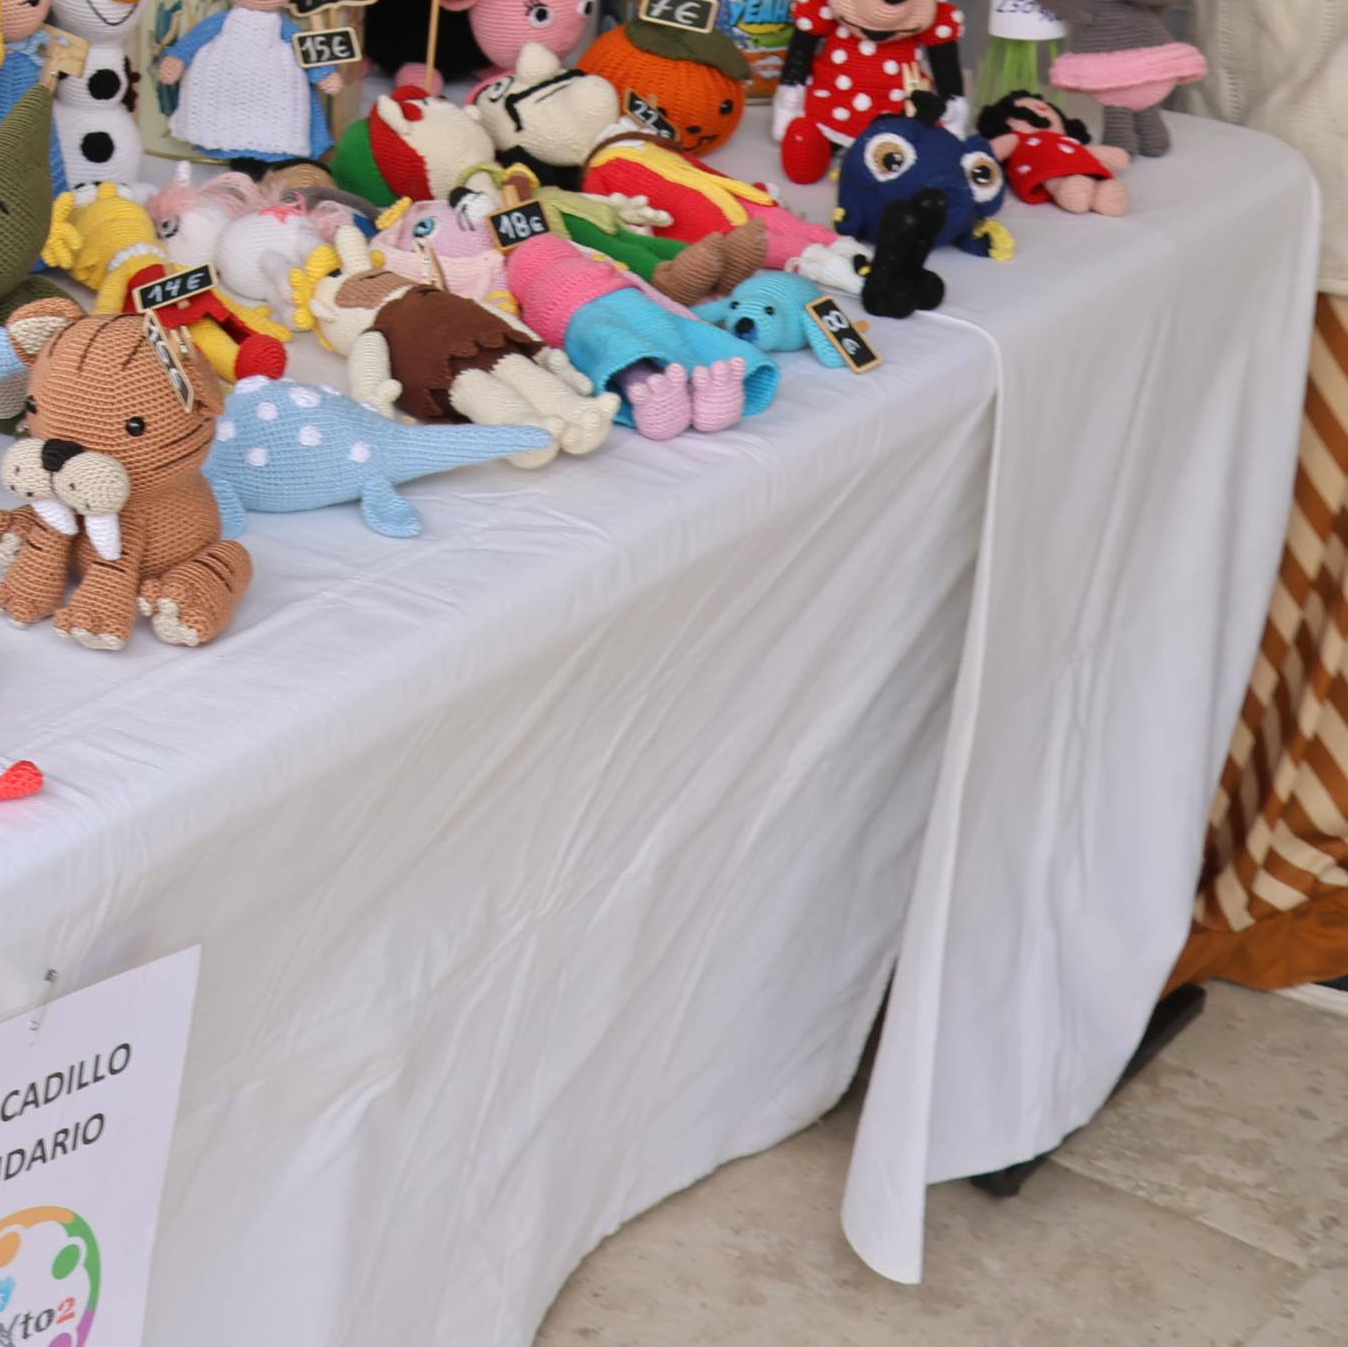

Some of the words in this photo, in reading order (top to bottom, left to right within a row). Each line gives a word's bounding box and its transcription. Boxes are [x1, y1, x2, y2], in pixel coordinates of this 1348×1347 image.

[301, 36, 349, 63] 15€
[499, 211, 546, 239] 18€
[822, 310, 861, 355] 8€
